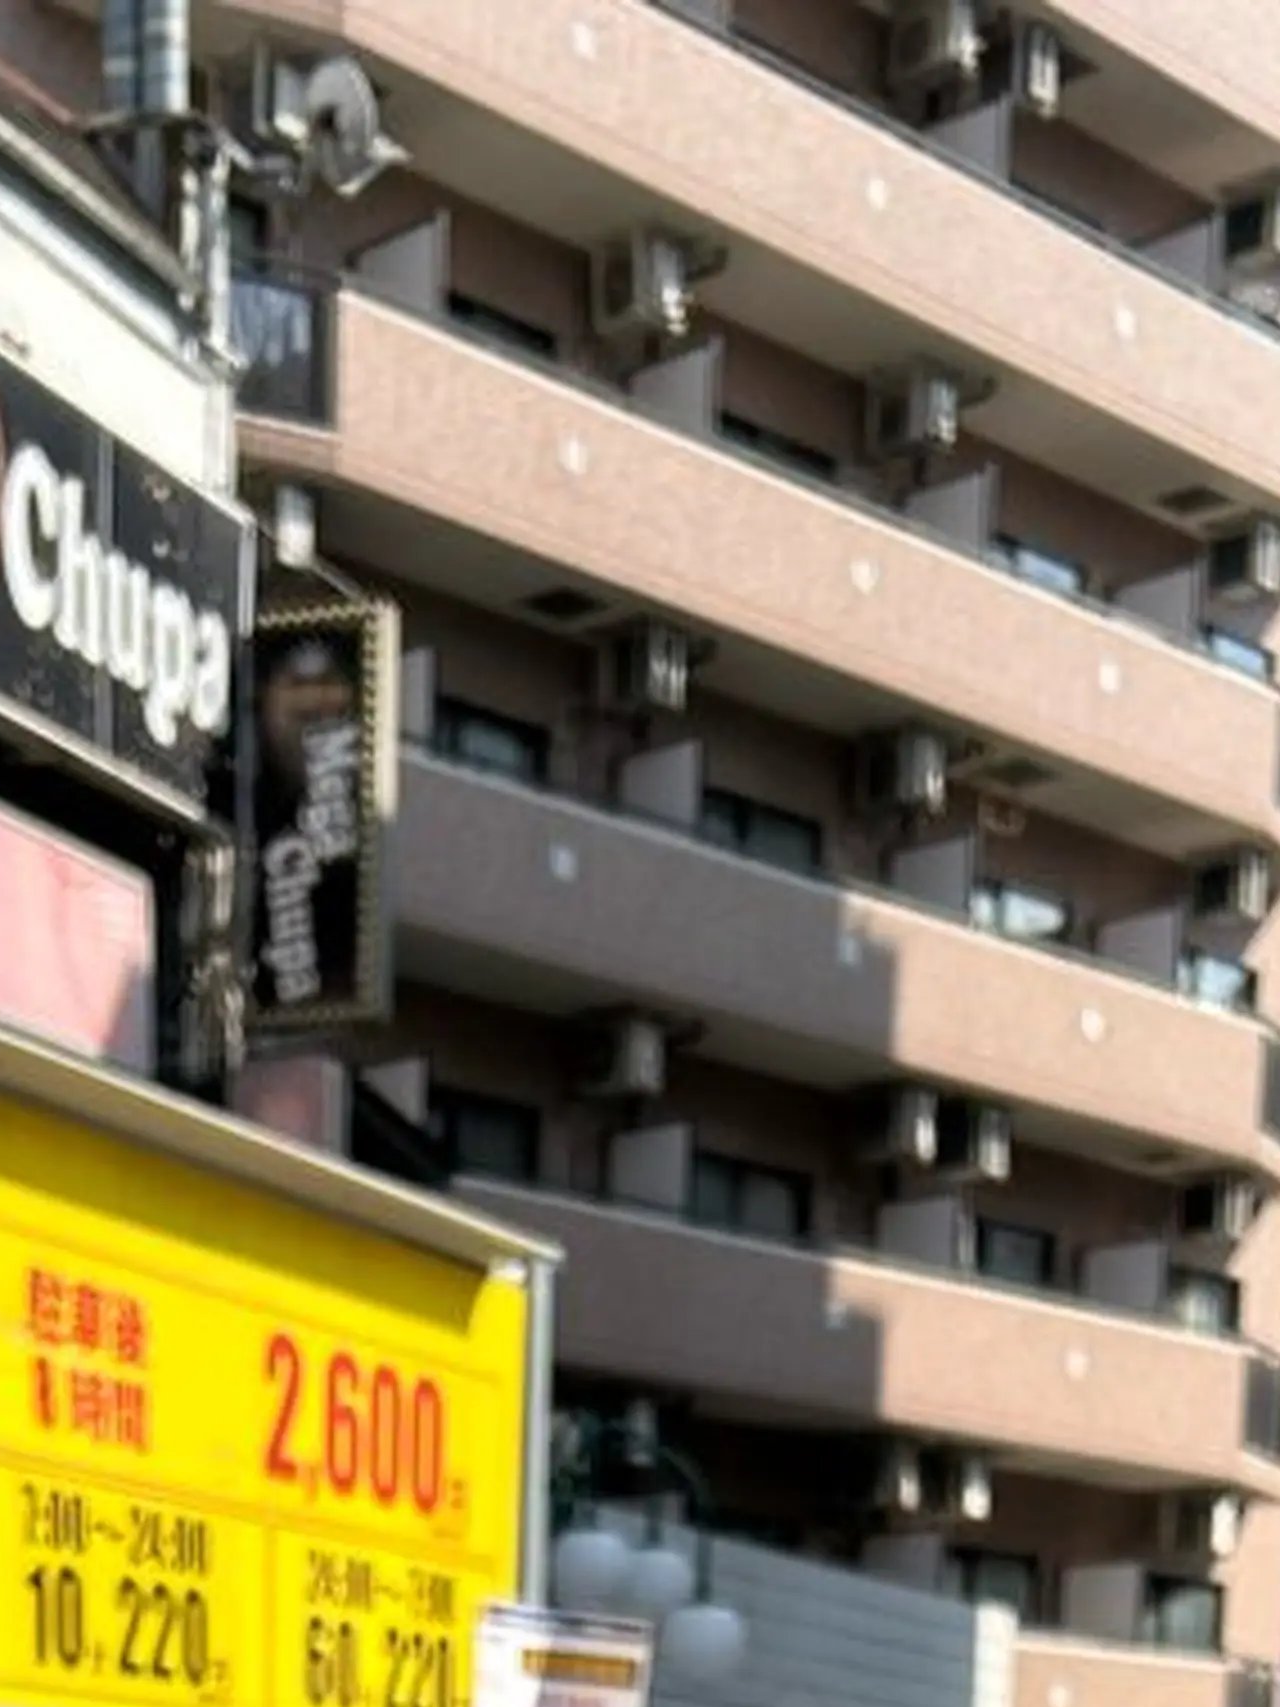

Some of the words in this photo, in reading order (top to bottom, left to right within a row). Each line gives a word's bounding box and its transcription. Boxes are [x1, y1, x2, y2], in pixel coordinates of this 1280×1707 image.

[1, 444, 231, 747] Chupa
[299, 722, 360, 864] Mega
[260, 832, 320, 1003] Chupa
[264, 1333, 443, 1516] 2,600
